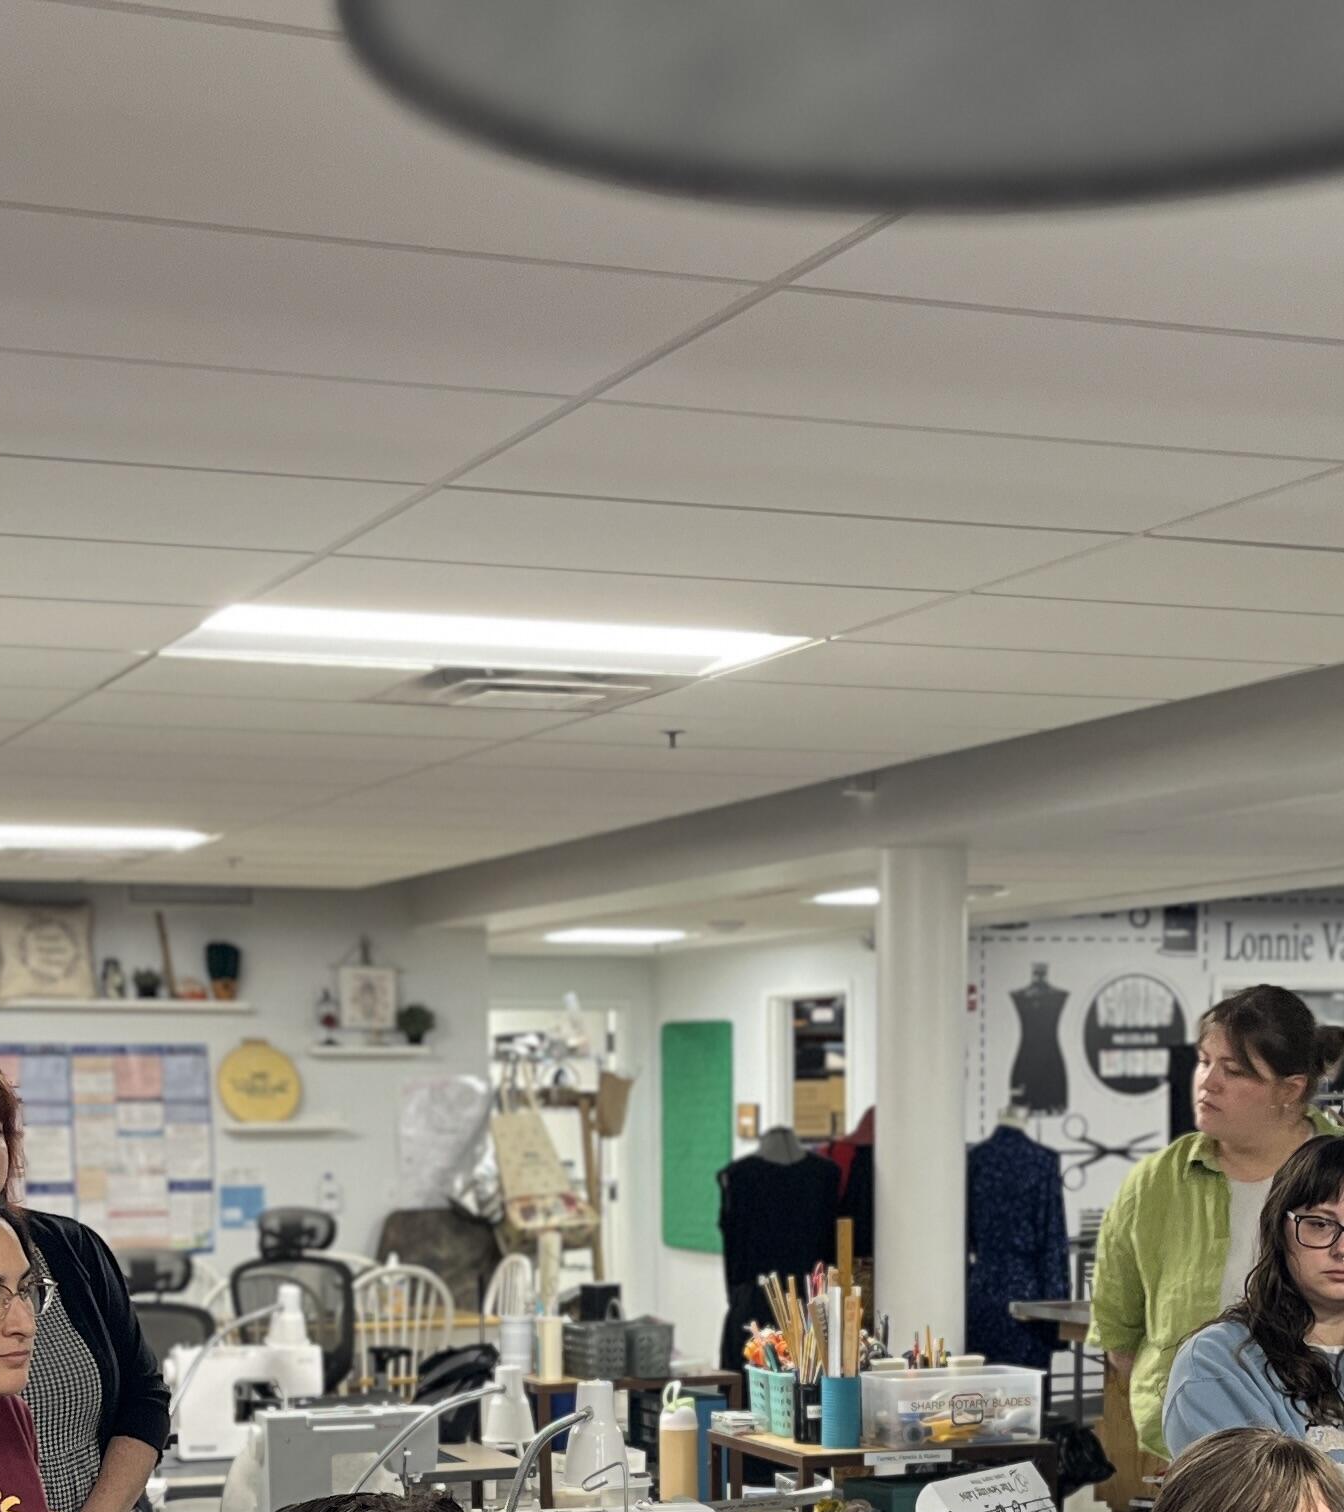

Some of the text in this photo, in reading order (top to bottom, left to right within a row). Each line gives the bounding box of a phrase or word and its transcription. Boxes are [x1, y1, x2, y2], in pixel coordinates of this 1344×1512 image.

[1224, 921, 1313, 962] Lonnie
[911, 1396, 1032, 1412] SHARP ROTARY BLADES
